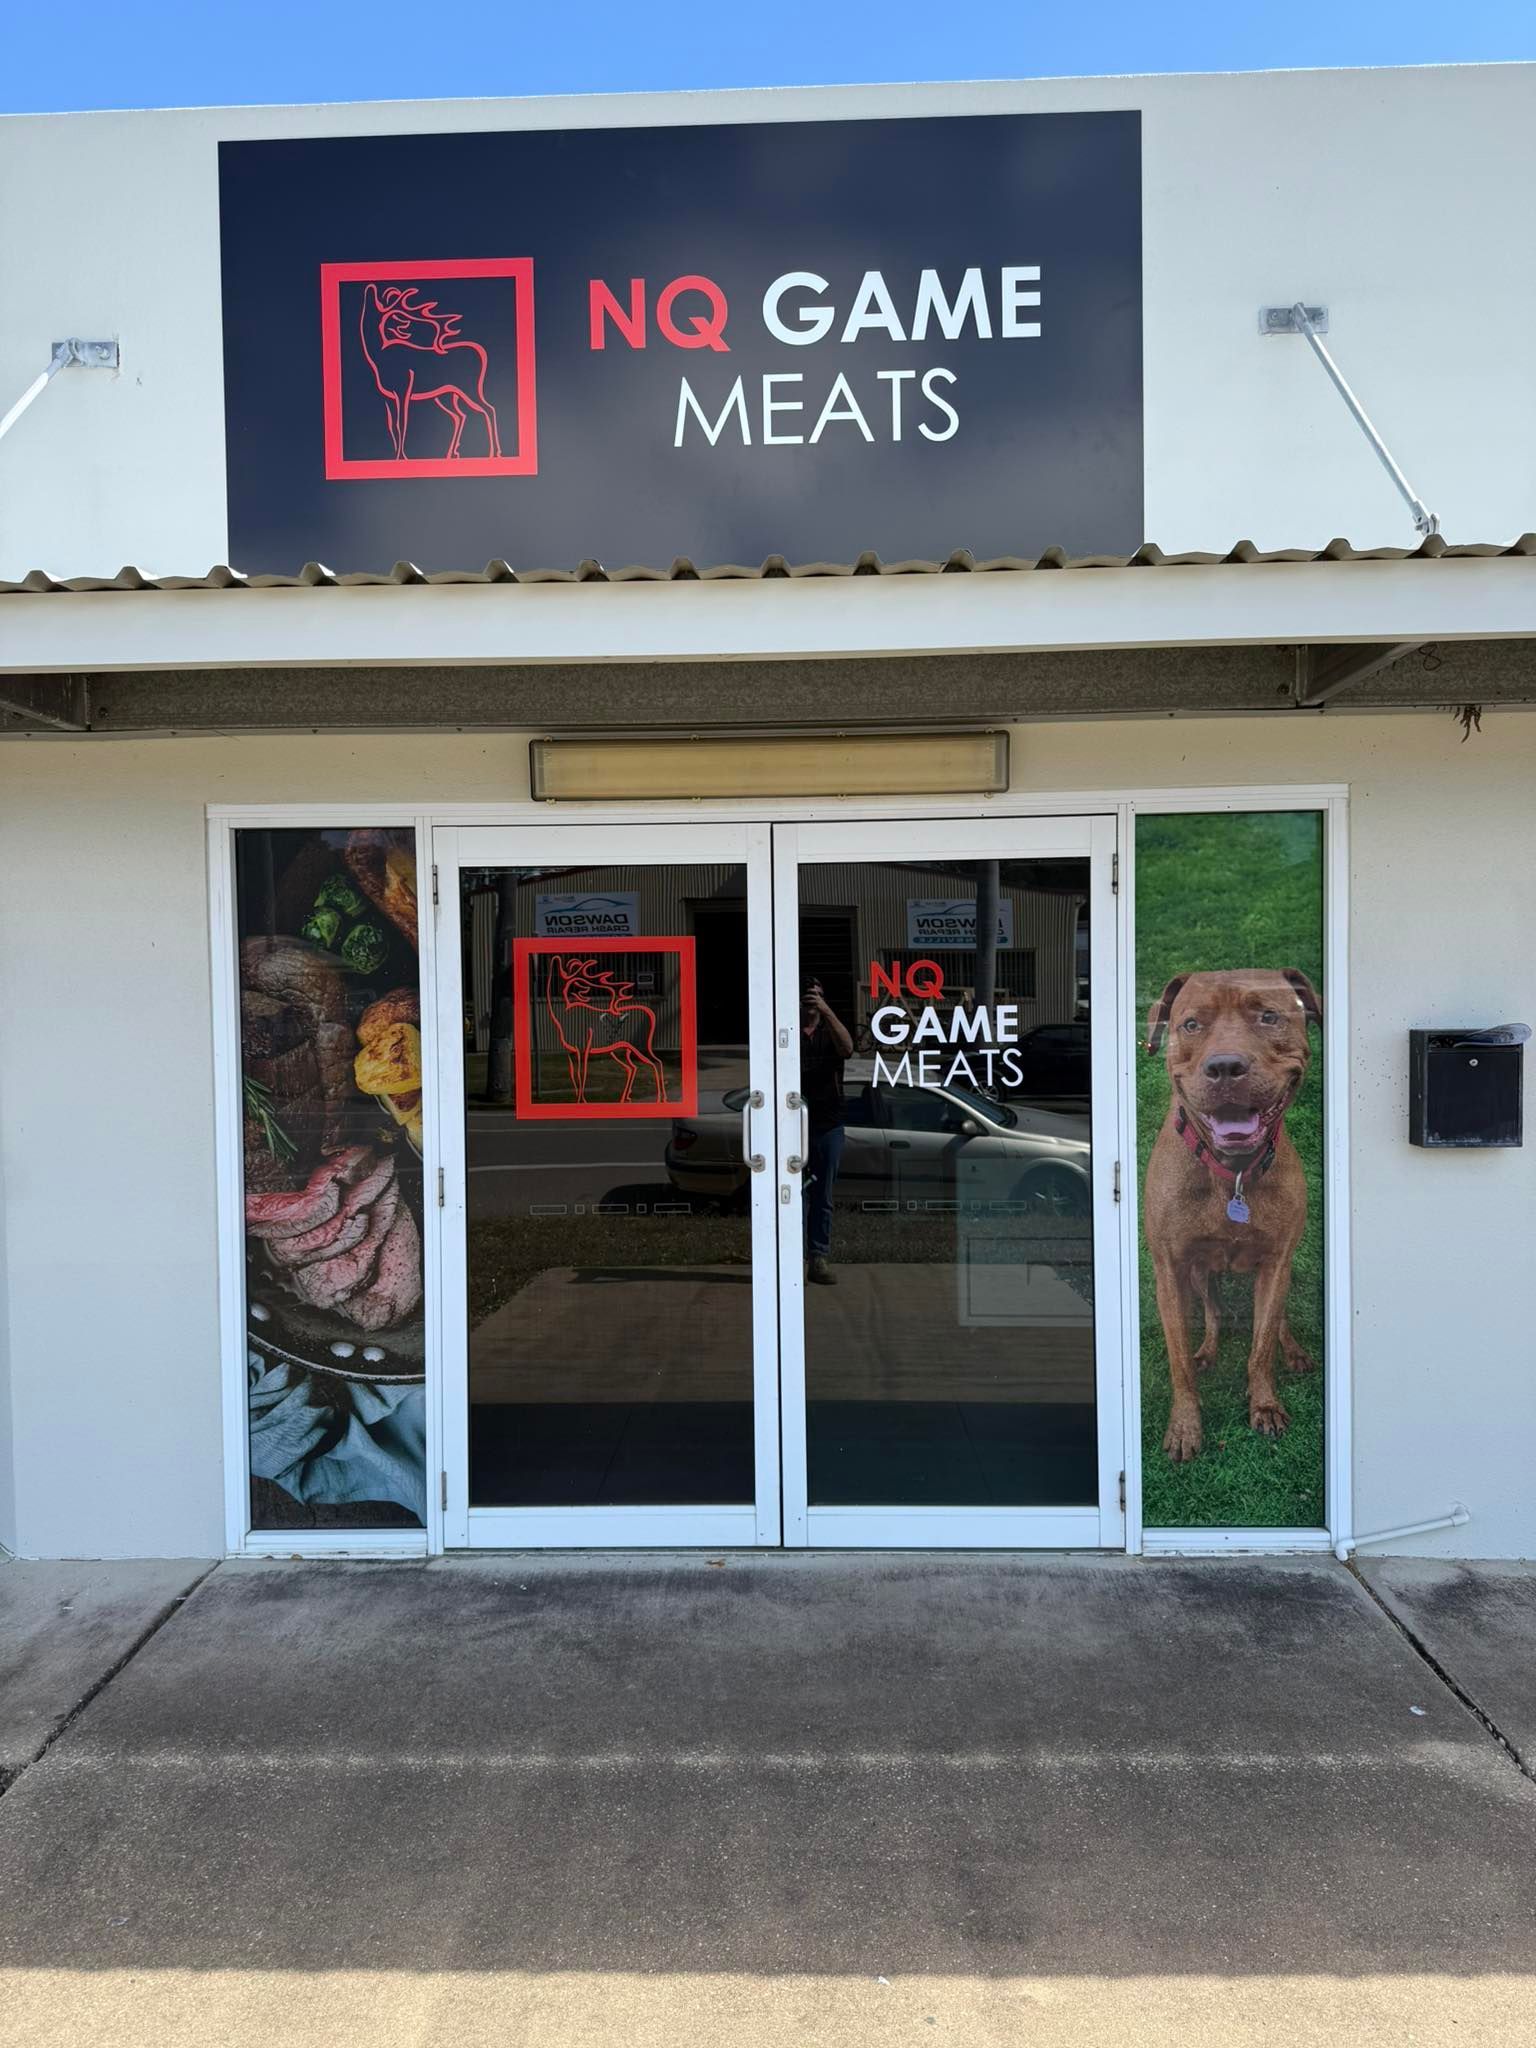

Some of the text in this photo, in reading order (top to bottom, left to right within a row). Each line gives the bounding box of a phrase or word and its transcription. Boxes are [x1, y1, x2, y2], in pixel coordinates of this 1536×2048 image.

[589, 265, 1041, 352] NQ GAME
[674, 367, 960, 447] MEATS
[870, 959, 945, 1000] NQ
[871, 1005, 1018, 1045] GAME
[872, 1048, 1024, 1088] MEATS
